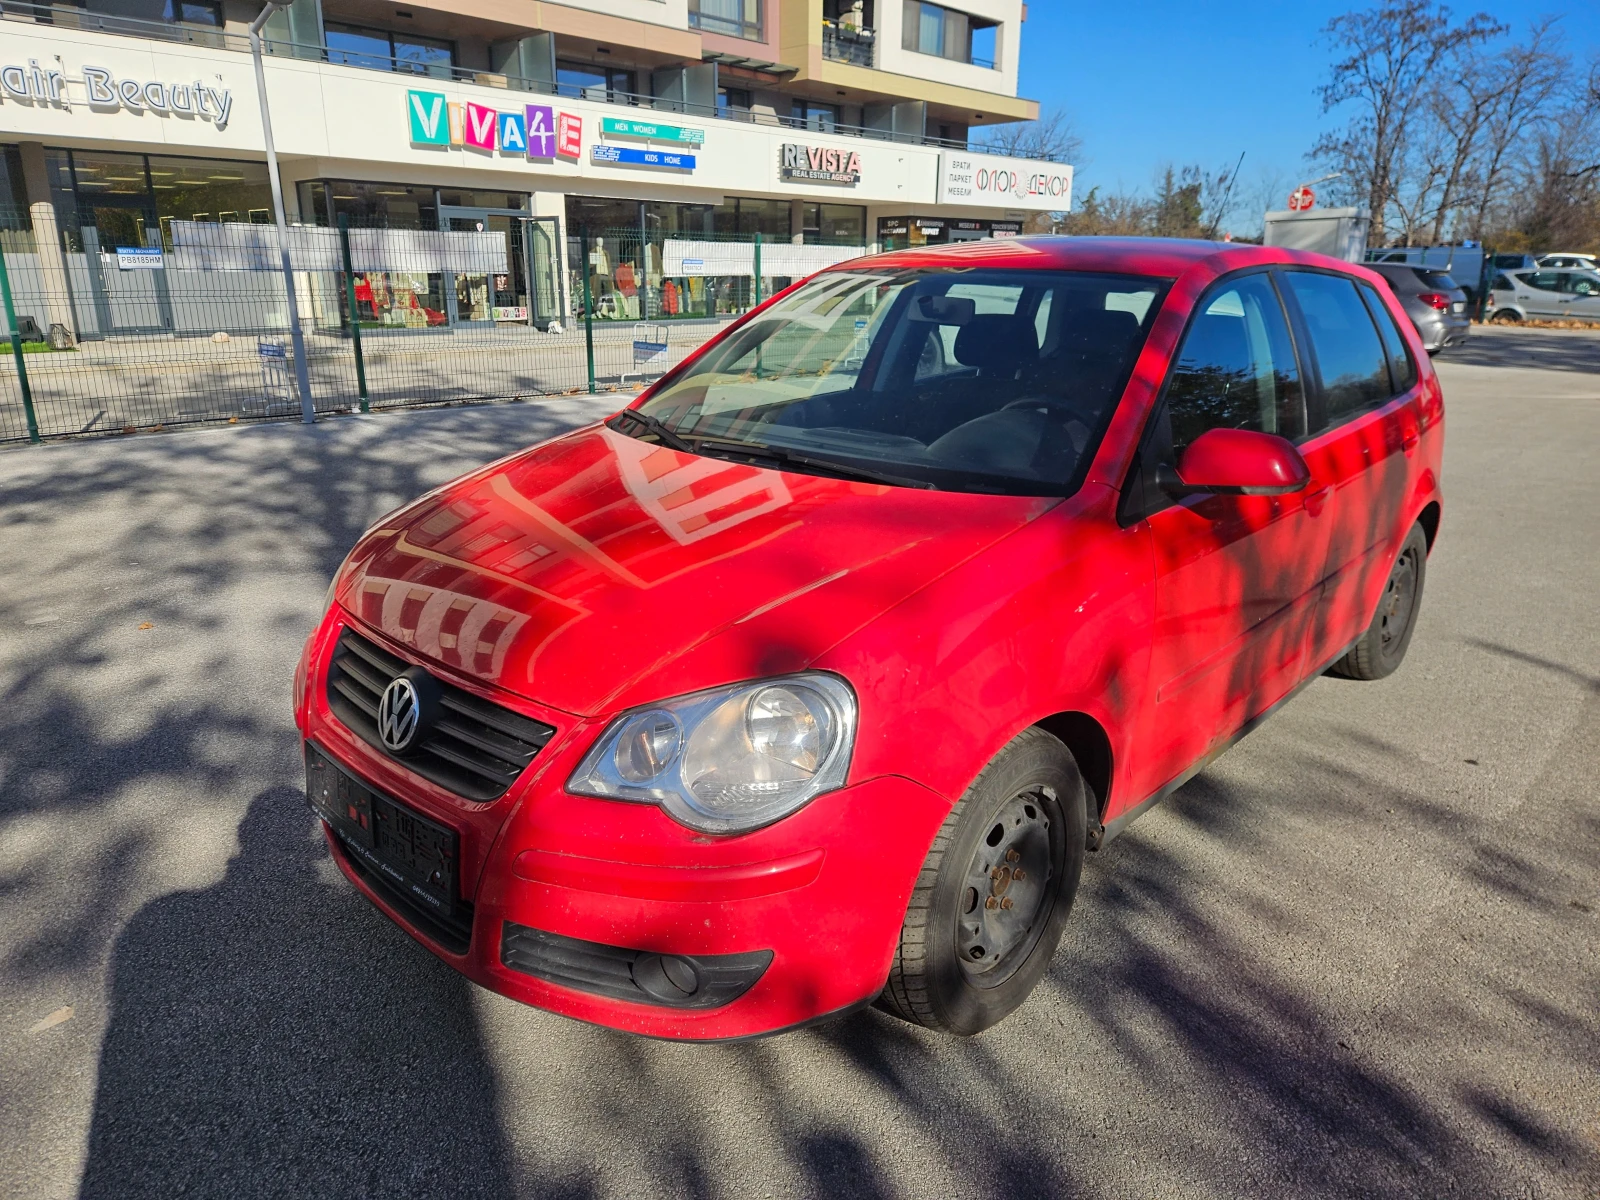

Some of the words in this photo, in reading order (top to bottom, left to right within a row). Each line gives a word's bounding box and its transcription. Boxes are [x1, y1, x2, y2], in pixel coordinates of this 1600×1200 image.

[82, 64, 232, 124] Beauty
[614, 122, 629, 131] MEN
[632, 124, 657, 134] WOMEN
[644, 153, 659, 163] KIDS
[664, 155, 682, 165] HOME
[783, 143, 862, 174] REVISTA
[952, 160, 971, 170] ВРАТИ
[792, 169, 809, 178] REAL
[809, 170, 831, 180] ESTATE
[831, 172, 855, 182] AGENCY
[948, 173, 972, 184] ПАРКЕТ
[948, 187, 972, 196] МЕБЕЛИ
[1290, 193, 1313, 207] SOP
